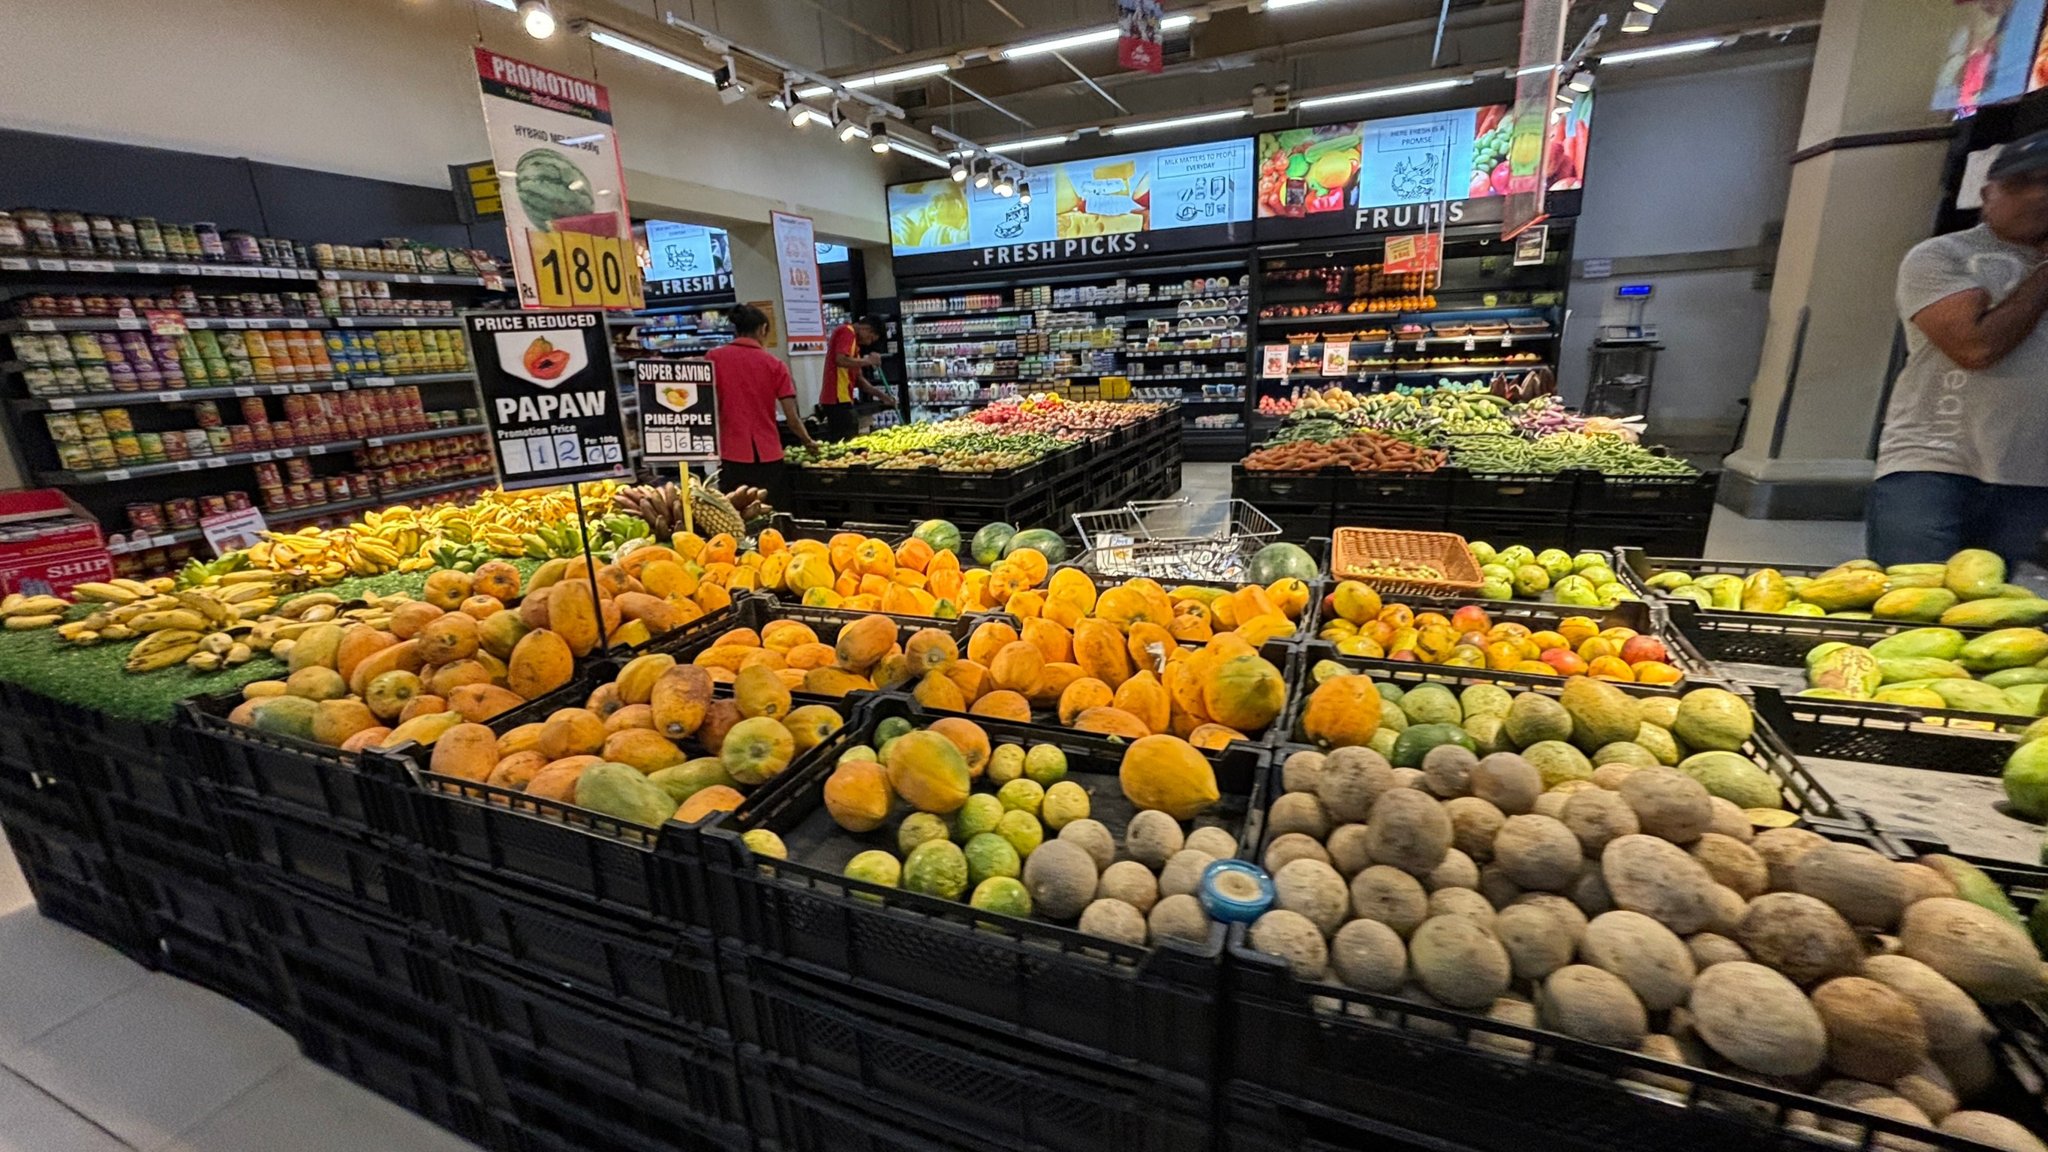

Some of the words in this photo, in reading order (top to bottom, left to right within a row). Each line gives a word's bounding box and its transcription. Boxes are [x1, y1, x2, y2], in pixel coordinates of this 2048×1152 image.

[491, 56, 597, 106] PROMOTION
[513, 125, 548, 142] HYBRID
[1179, 155, 1205, 163] MATTERS
[1186, 162, 1215, 171] EVERYDAY
[1355, 201, 1463, 230] FRUITS
[983, 241, 1056, 265] FRESH
[1065, 233, 1137, 257] PICKS
[541, 247, 621, 296] 180
[474, 316, 523, 331] PRICE
[526, 313, 597, 329] REDUCED
[638, 363, 673, 380] SUPER
[675, 365, 711, 382] SAVING
[495, 390, 606, 424] PAPAW
[644, 413, 712, 425] PINEAPPLE
[497, 426, 549, 439] Promotion
[550, 424, 577, 434] Price
[46, 560, 110, 578] SHIP
